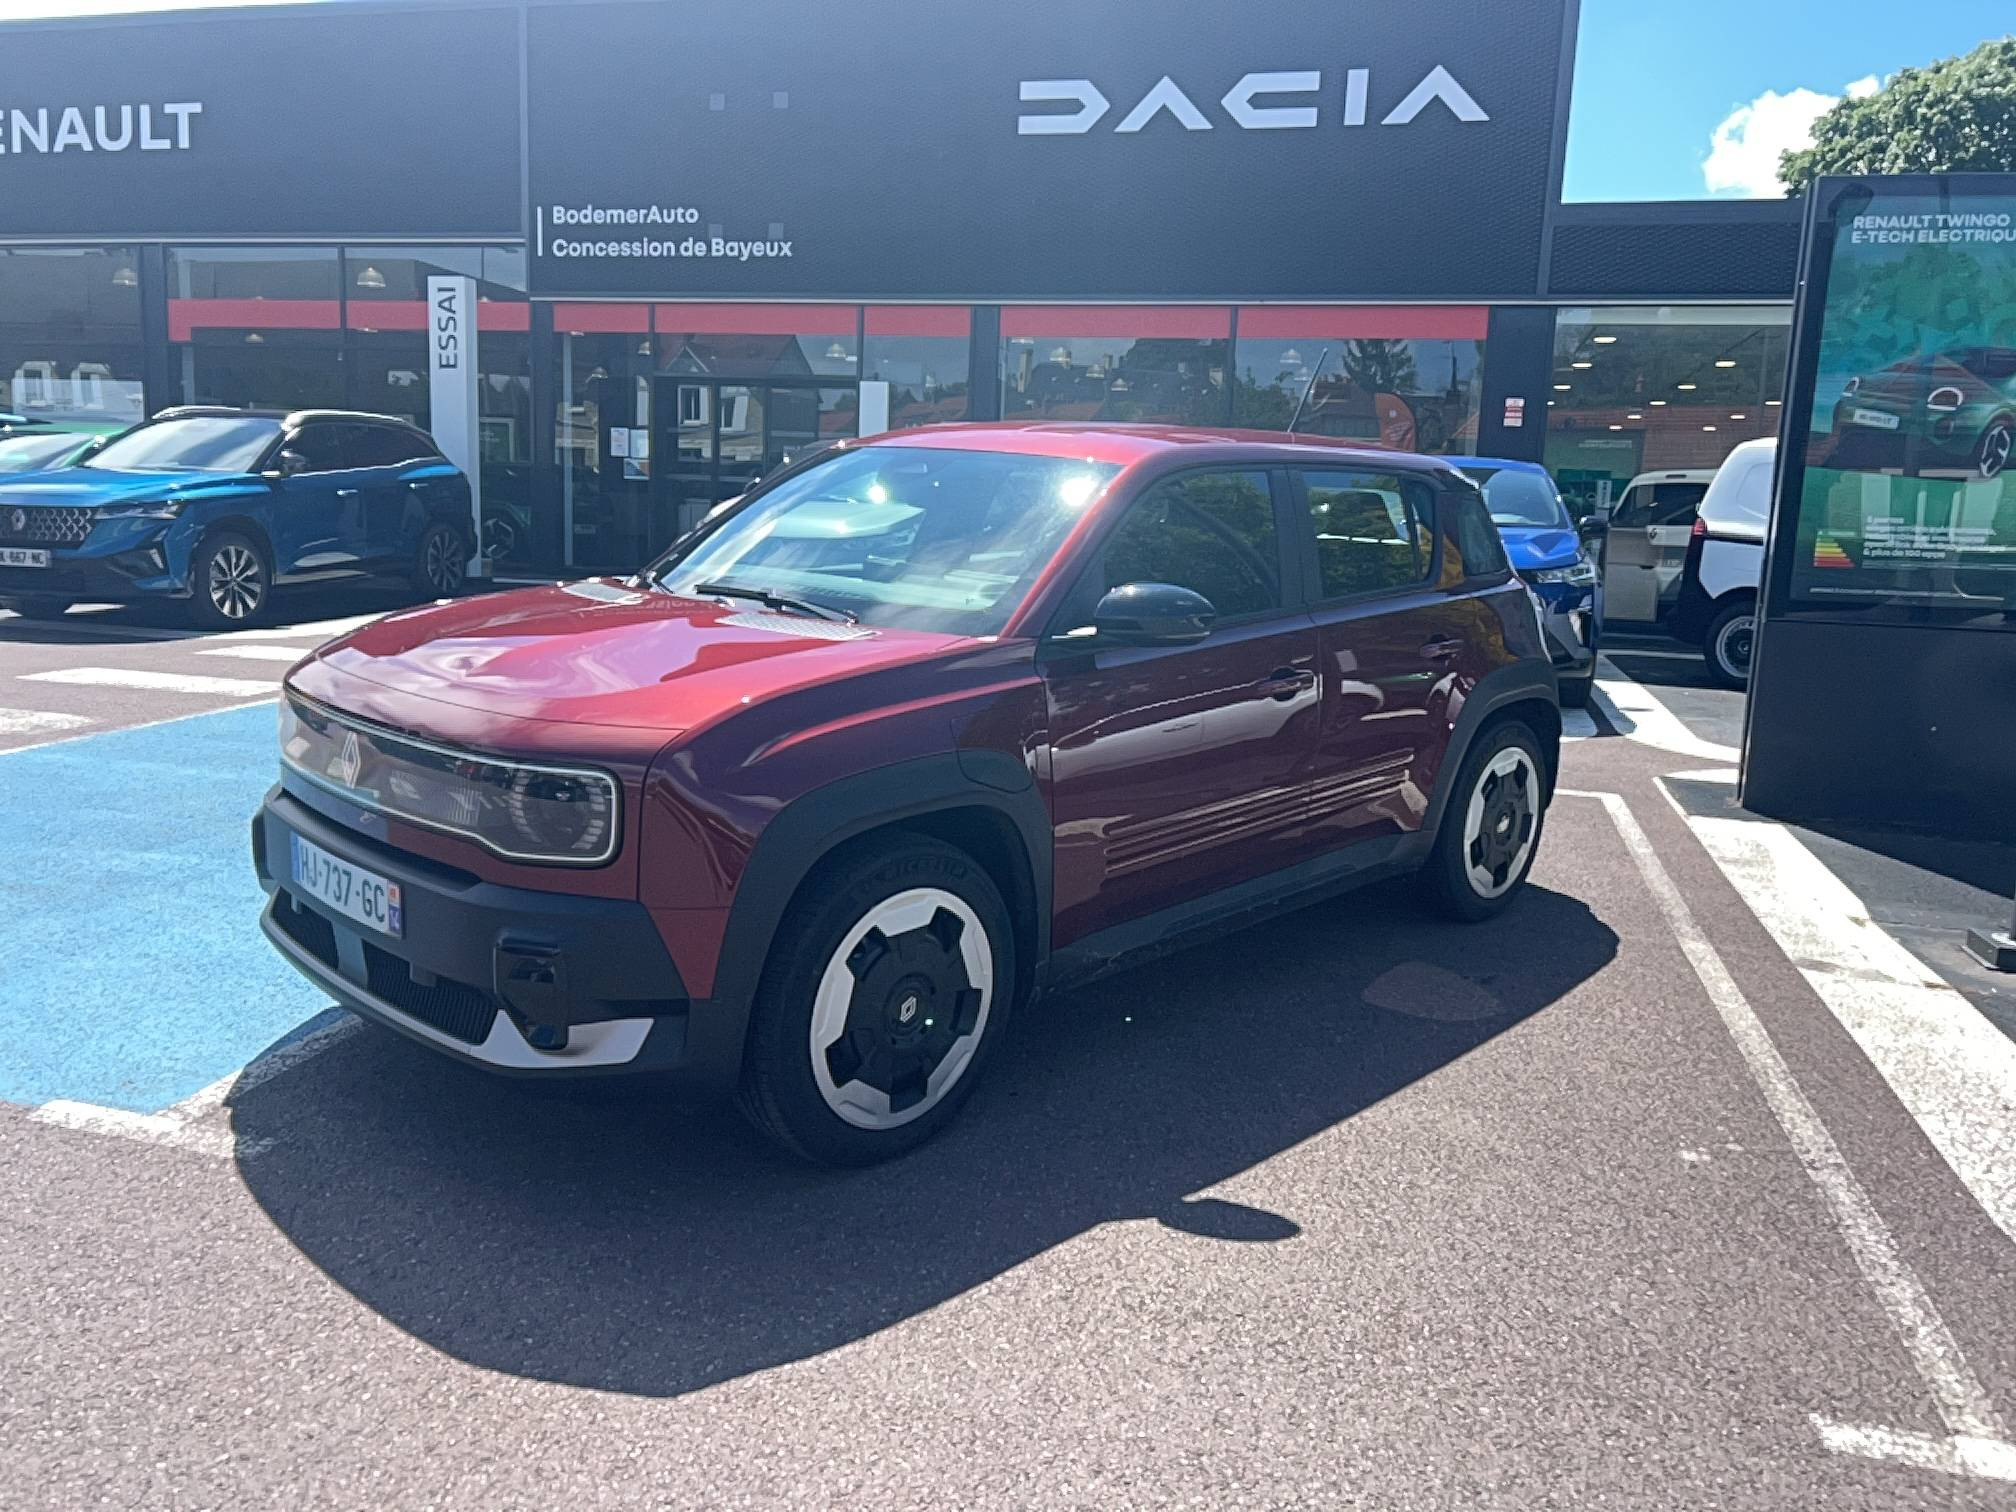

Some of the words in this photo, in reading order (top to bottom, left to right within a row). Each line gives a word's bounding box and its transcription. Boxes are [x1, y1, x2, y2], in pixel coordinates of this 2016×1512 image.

[1017, 65, 1490, 135] DACIA
[0, 102, 202, 154] NAULT
[552, 204, 699, 225] BodemerAuto
[1853, 215, 1933, 229] RENAULT
[1935, 213, 2011, 228] TWINGO
[552, 237, 676, 257] Concession
[680, 237, 707, 257] de
[710, 238, 792, 262] Bayeux
[1851, 230, 1914, 244] E-TECH
[437, 286, 457, 370] ESSAI
[300, 845, 386, 923] HJ-737-GC
